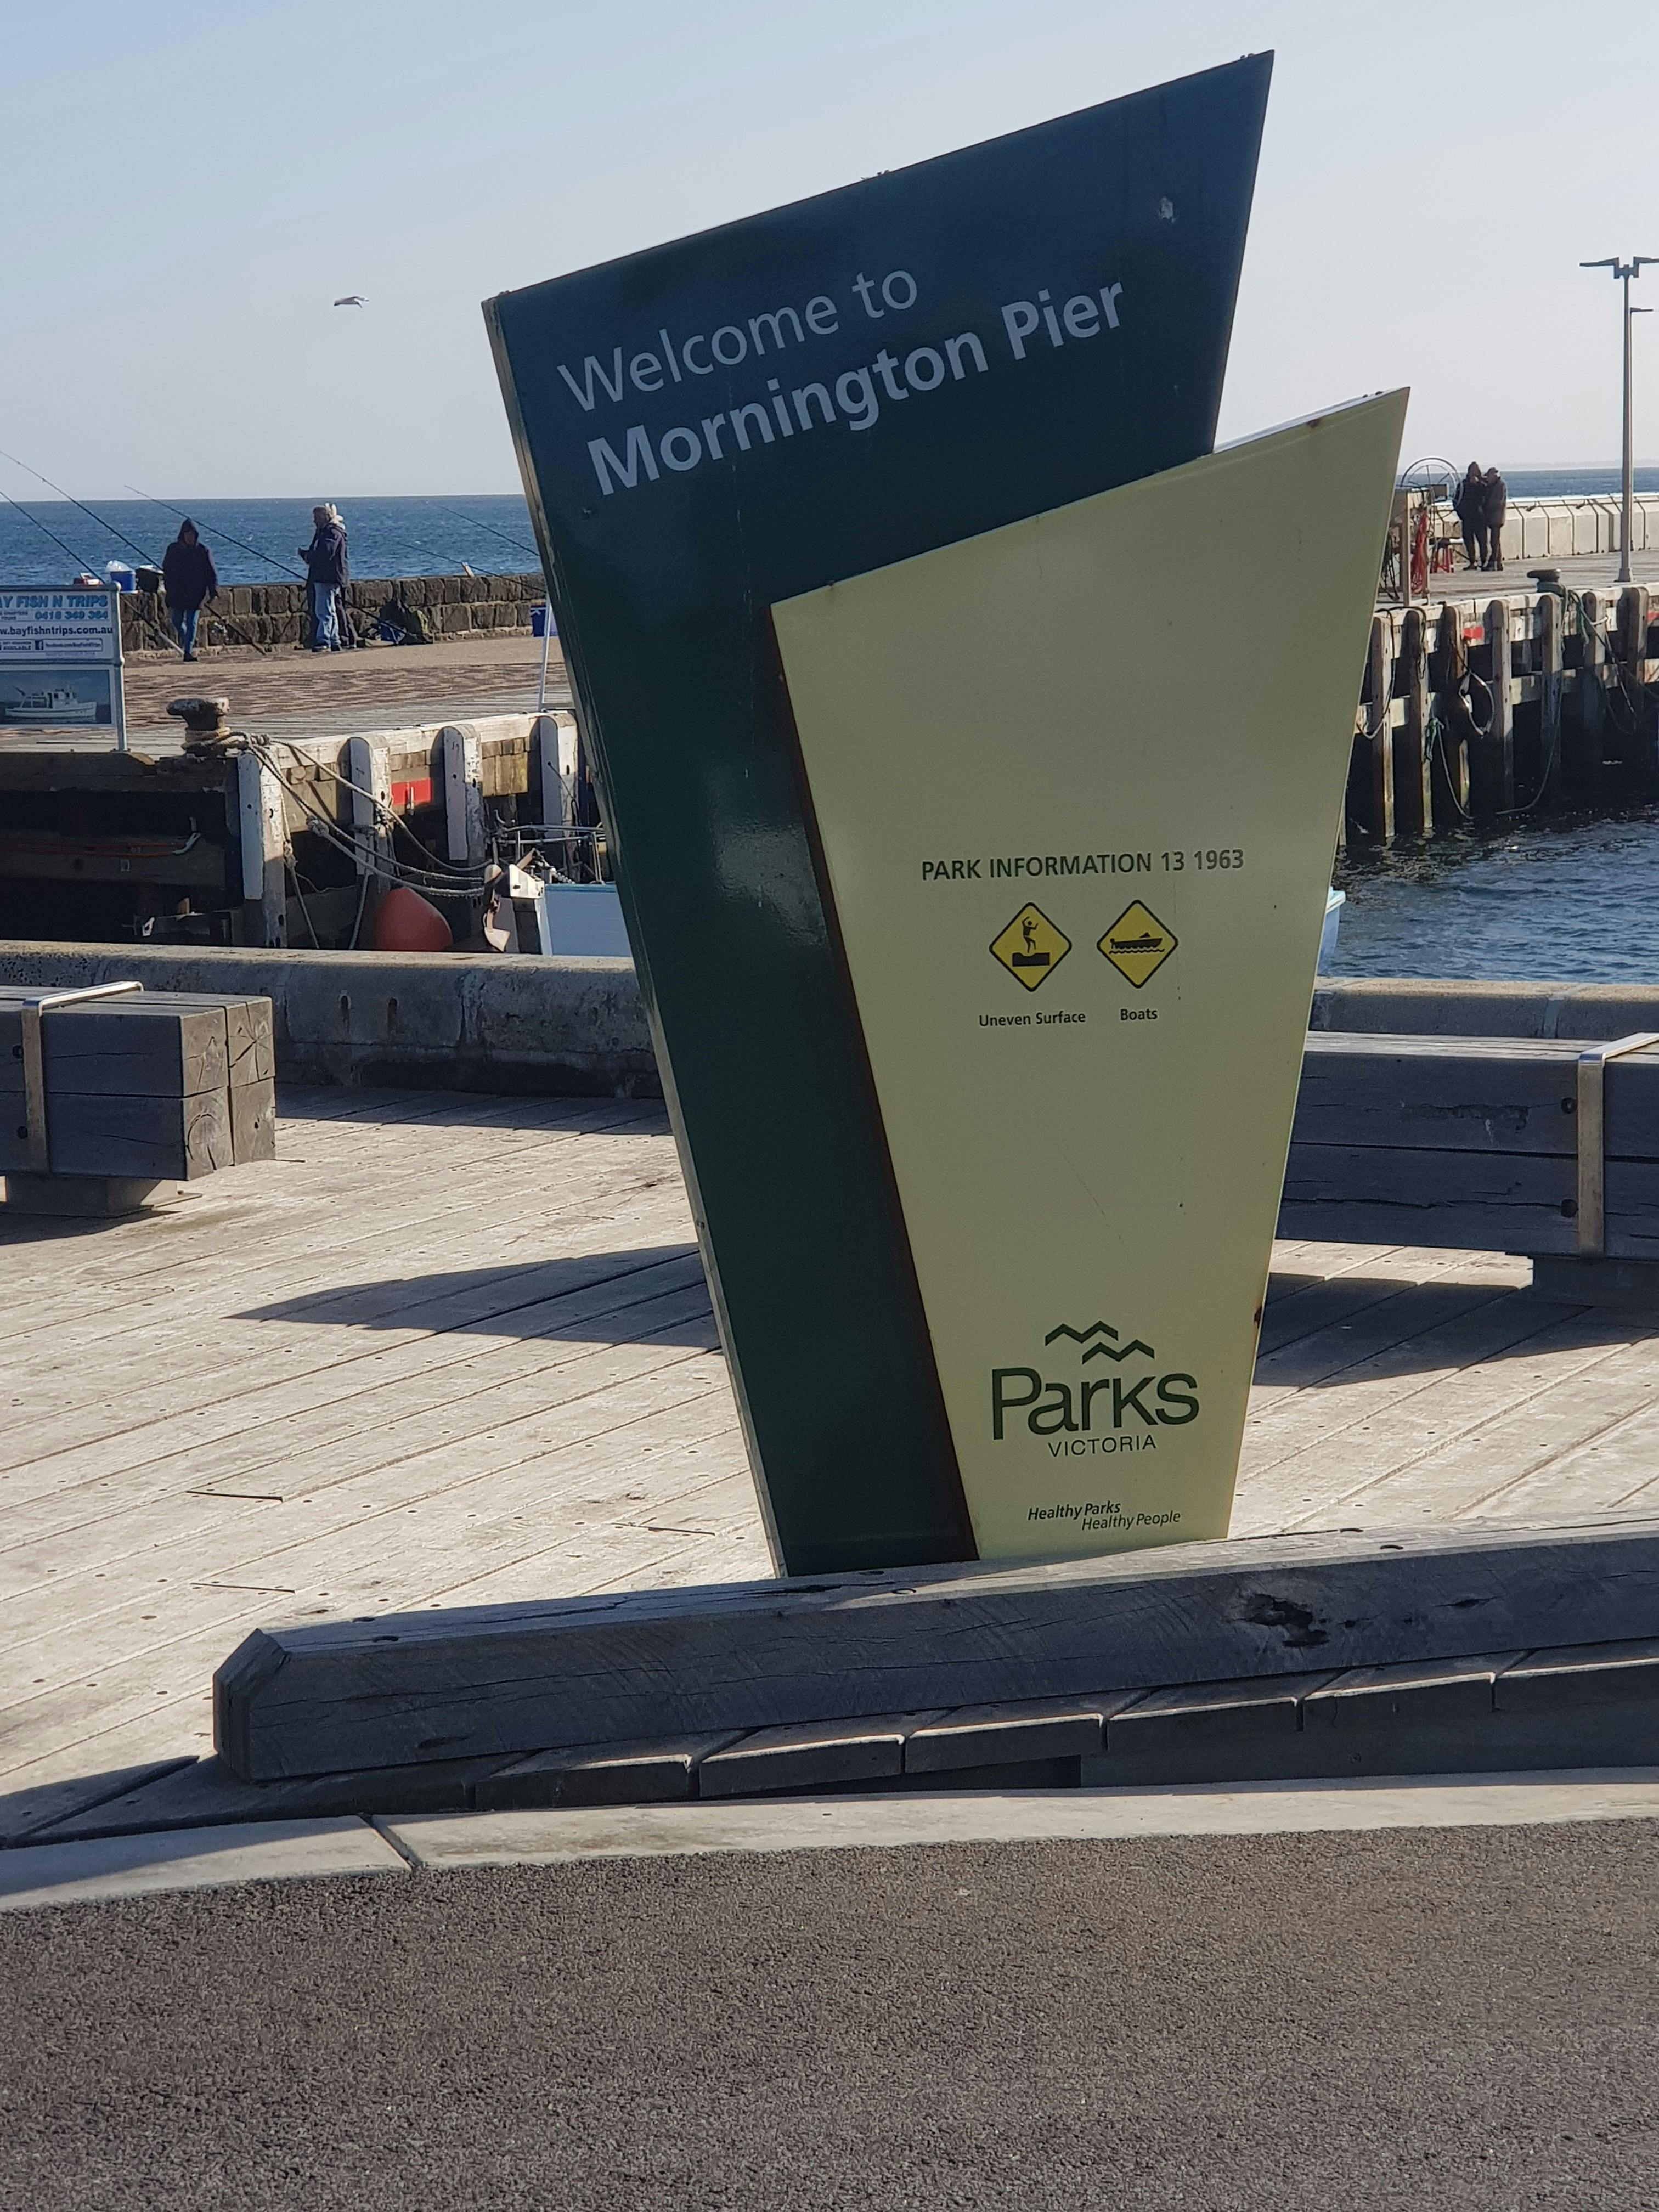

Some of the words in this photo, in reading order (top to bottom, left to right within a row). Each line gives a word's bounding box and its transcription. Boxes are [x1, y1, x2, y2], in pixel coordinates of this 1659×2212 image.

[557, 294, 839, 411] Welcome
[851, 270, 917, 318] to
[587, 332, 988, 495] Mornington
[1001, 282, 1123, 360] Pier
[0, 596, 13, 608] Y
[16, 595, 48, 608] FISH
[52, 595, 63, 608] N
[66, 595, 108, 607] TRIPS
[922, 859, 982, 881] PARK
[989, 853, 1152, 878] INFORMATION
[1161, 851, 1185, 871] 13
[1194, 849, 1244, 871] 1963
[979, 1013, 1031, 1028] Uneven
[1036, 1010, 1086, 1025] Surface
[1120, 1008, 1159, 1022] Boats
[991, 1367, 1200, 1440] Parks
[1047, 1434, 1156, 1458] VICTORIA
[1028, 1504, 1083, 1521] Healthy
[1084, 1500, 1121, 1517] Parks
[1081, 1514, 1135, 1531] Healthy
[1136, 1509, 1181, 1527] People
